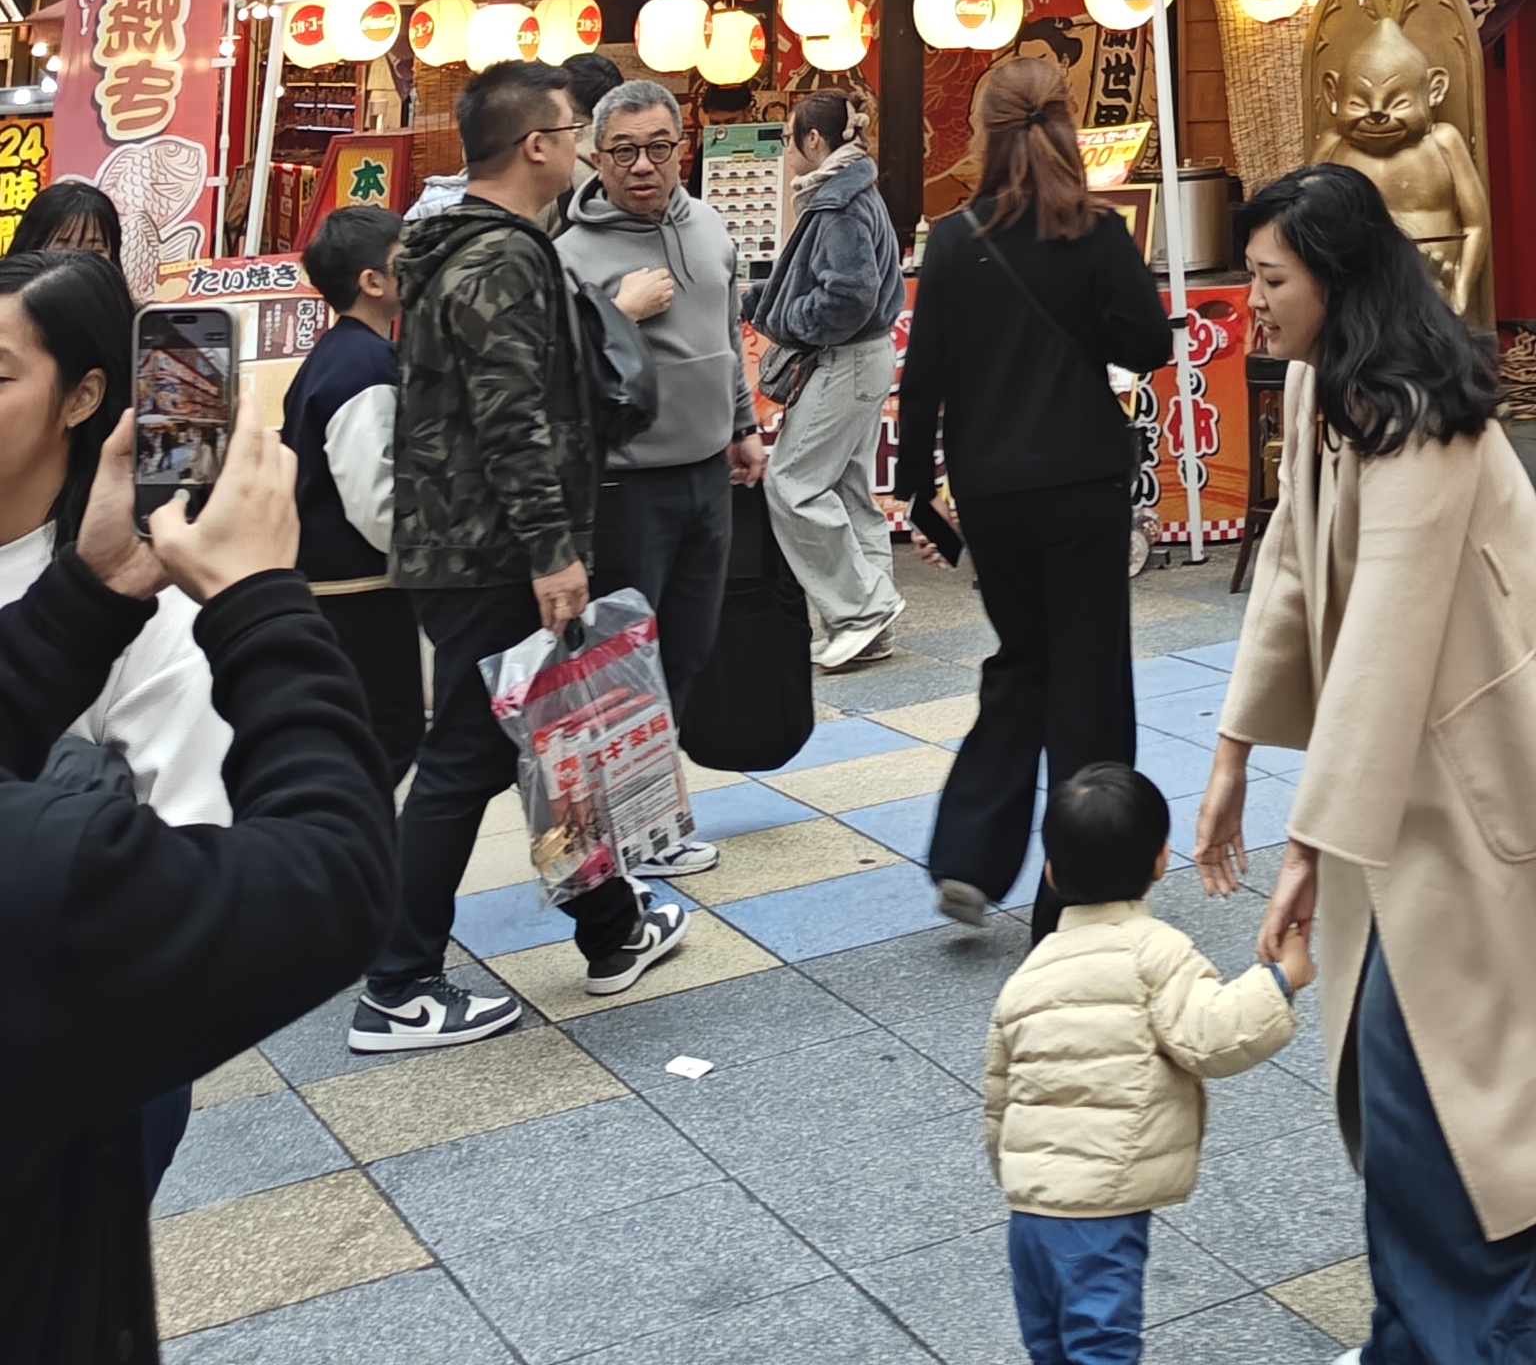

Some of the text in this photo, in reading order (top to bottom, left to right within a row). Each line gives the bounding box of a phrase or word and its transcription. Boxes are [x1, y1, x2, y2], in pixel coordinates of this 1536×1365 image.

[191, 263, 298, 293] たい焼き
[299, 303, 314, 348] あんこ
